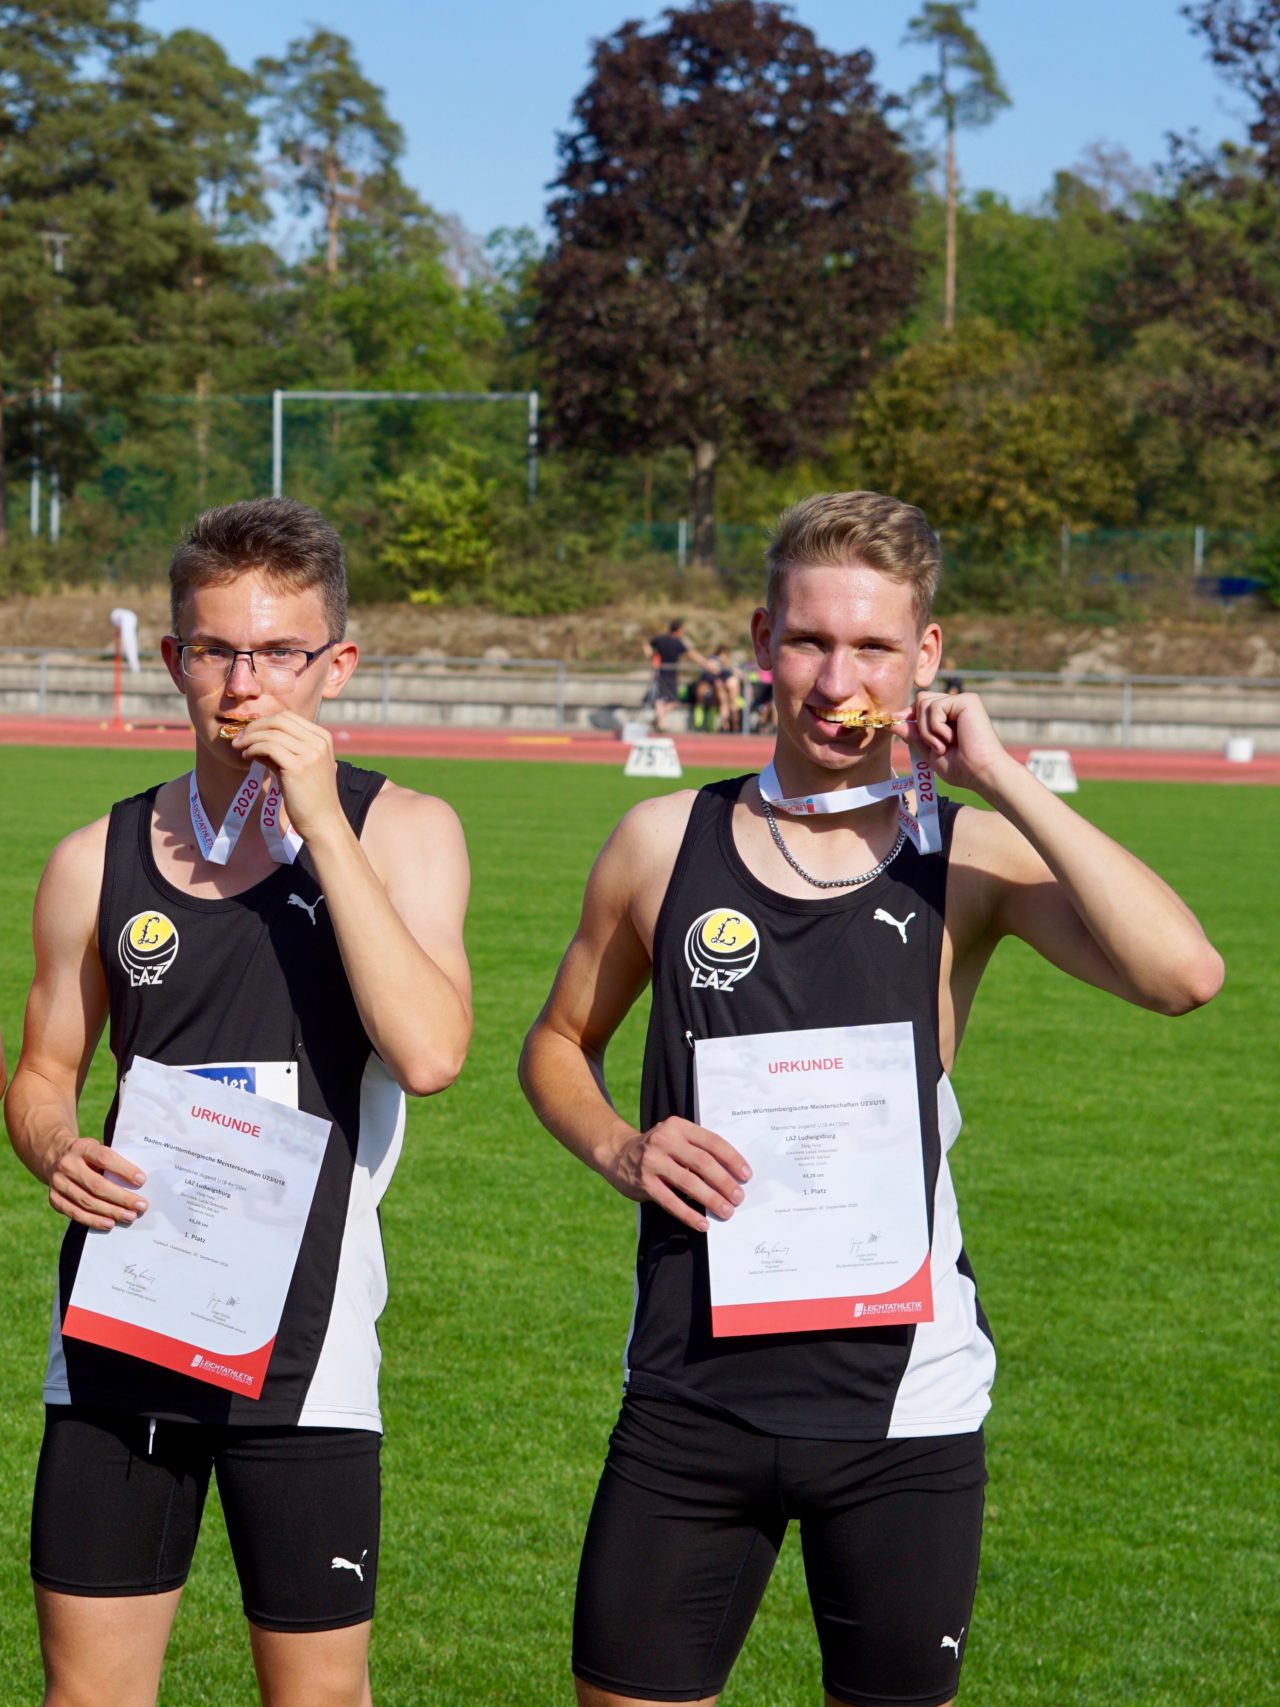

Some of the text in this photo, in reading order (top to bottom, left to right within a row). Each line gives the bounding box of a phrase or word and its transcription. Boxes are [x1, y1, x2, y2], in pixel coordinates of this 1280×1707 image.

[631, 744, 656, 768] 75
[916, 761, 933, 802] 2020
[233, 779, 258, 817] 2020
[263, 787, 281, 827] 2020
[130, 965, 165, 987] LAZ
[690, 967, 742, 992] LAZ
[768, 1057, 844, 1074] URKUNDE
[810, 1101, 859, 1110] Meisterschaften
[191, 1105, 262, 1138] URKUNDE
[798, 1133, 836, 1141] Ludwigsburg
[216, 1158, 261, 1178] Meisterschaften
[184, 1178, 231, 1199] LAZ Ludwigsburg
[191, 1233, 206, 1243] Platz
[863, 1301, 922, 1312] LEICHTATHLETIK
[200, 1358, 254, 1383] LEICHTATHLETIK
